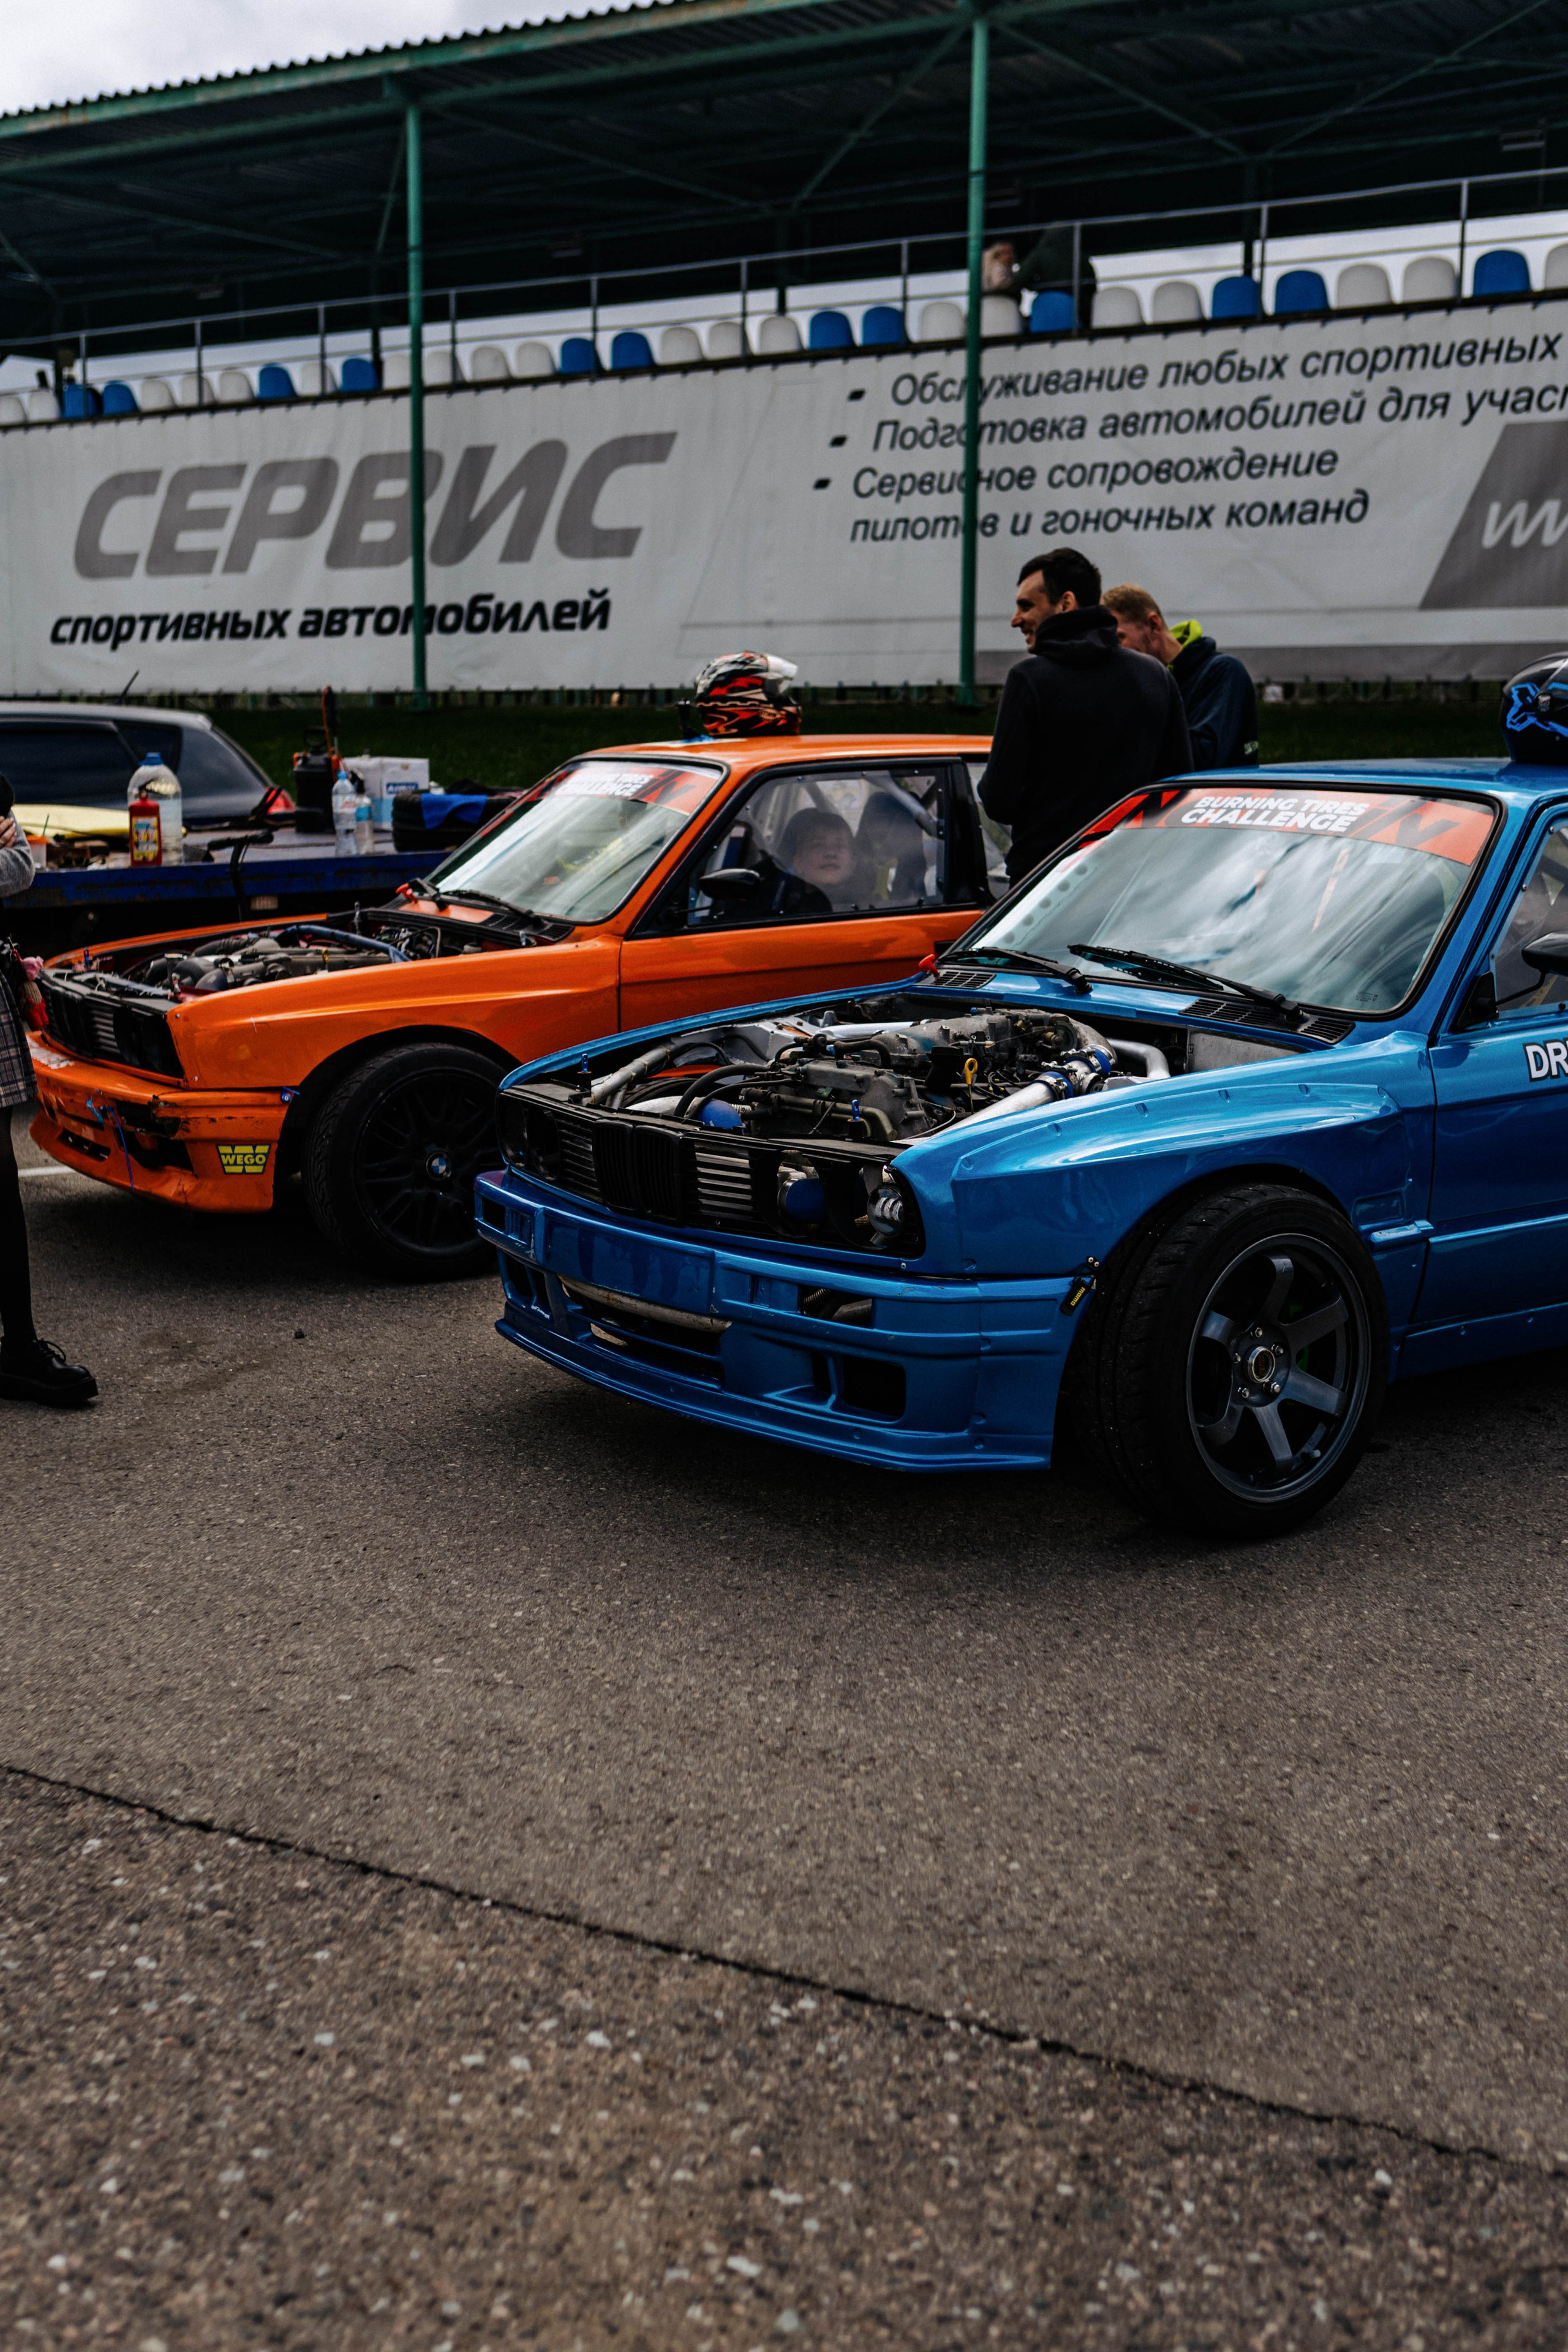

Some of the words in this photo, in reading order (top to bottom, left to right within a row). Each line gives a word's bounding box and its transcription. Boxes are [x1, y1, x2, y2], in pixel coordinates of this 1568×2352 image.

[1158, 349, 1288, 388] любых
[1300, 332, 1563, 381] спортивных
[1098, 390, 1367, 438] автомобилей
[1378, 385, 1451, 423] для
[1047, 446, 1339, 493] сопровождение
[73, 431, 677, 581] СЕРВИС
[850, 512, 1000, 542] пилотв
[1010, 511, 1033, 537] и
[1041, 502, 1217, 535] гоночных
[1225, 488, 1371, 530] команд
[50, 609, 291, 652] спортивных
[298, 587, 611, 637] автомобилей
[1181, 808, 1358, 832] CHALLENGE
[1194, 796, 1298, 810] BURNING
[1301, 798, 1371, 816] TIRES
[1525, 1039, 1568, 1080] DR
[221, 1154, 266, 1165] WEGO
[1070, 1286, 1085, 1306] momo
